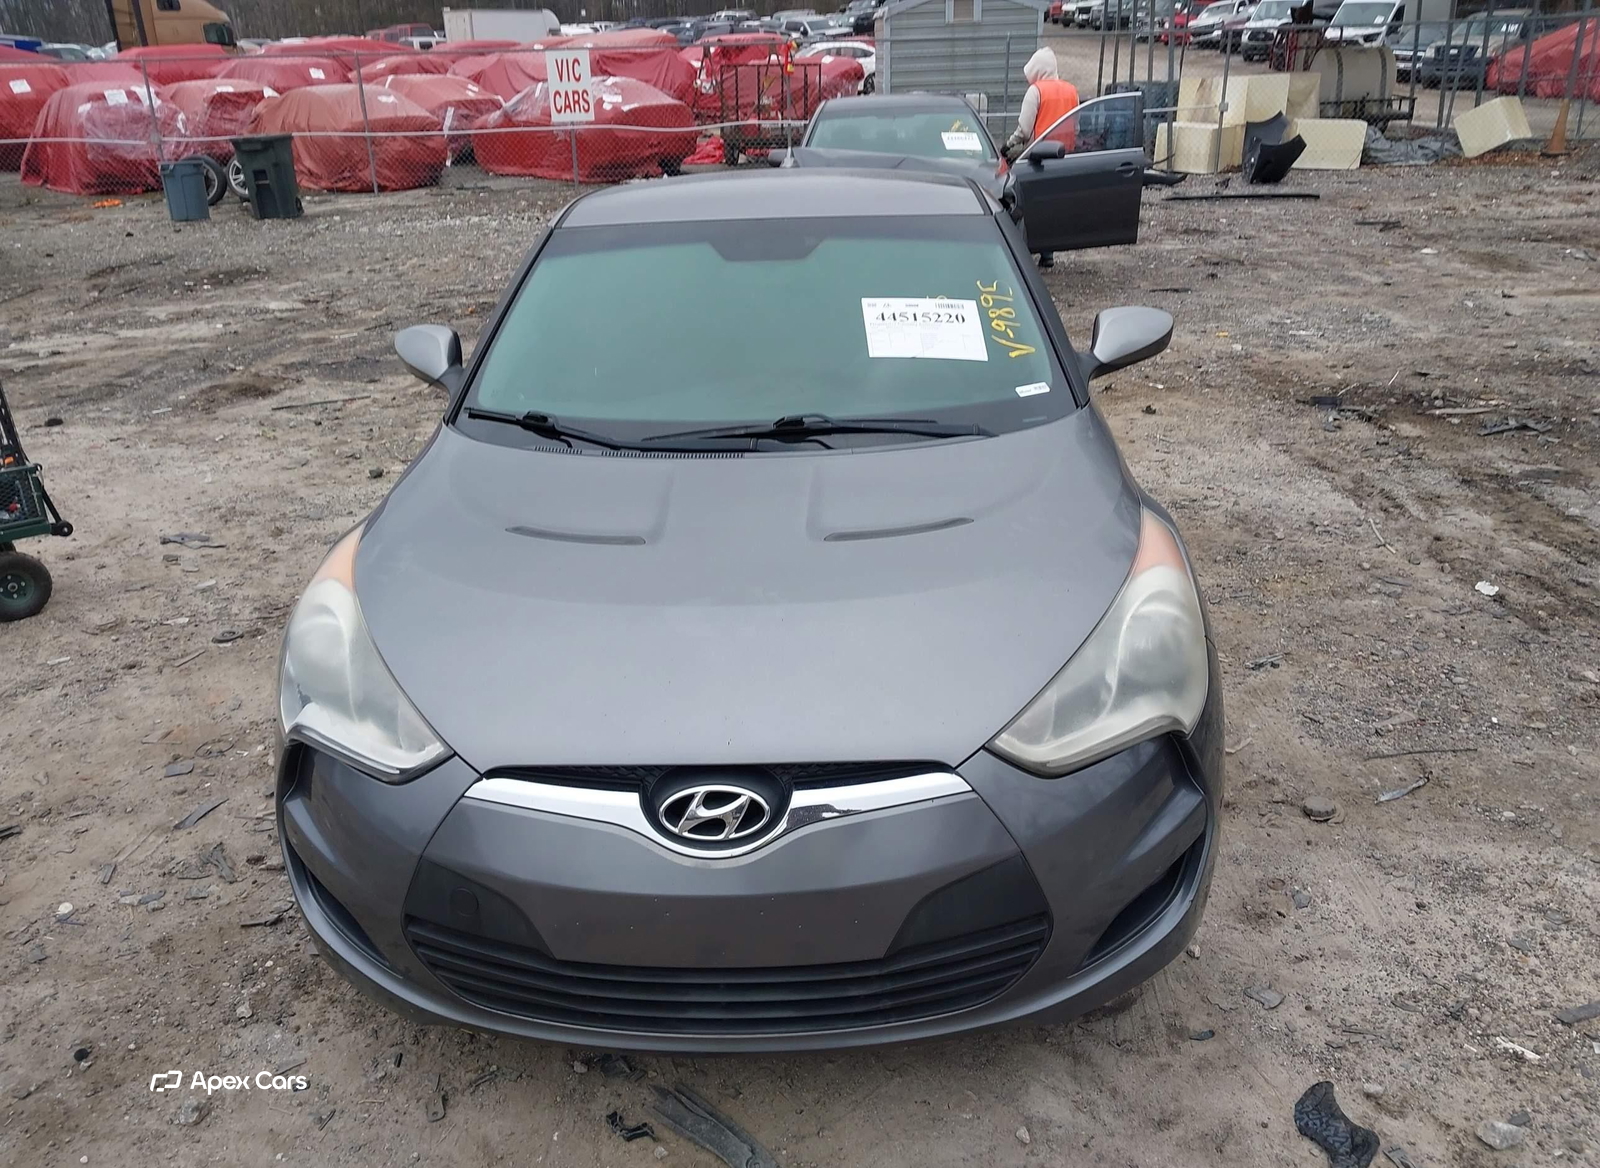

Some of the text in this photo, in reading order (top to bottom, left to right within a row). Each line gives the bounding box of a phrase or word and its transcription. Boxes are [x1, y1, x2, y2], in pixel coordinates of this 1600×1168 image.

[555, 57, 582, 82] VIC
[553, 89, 590, 114] CARS
[876, 311, 966, 325] 44515220
